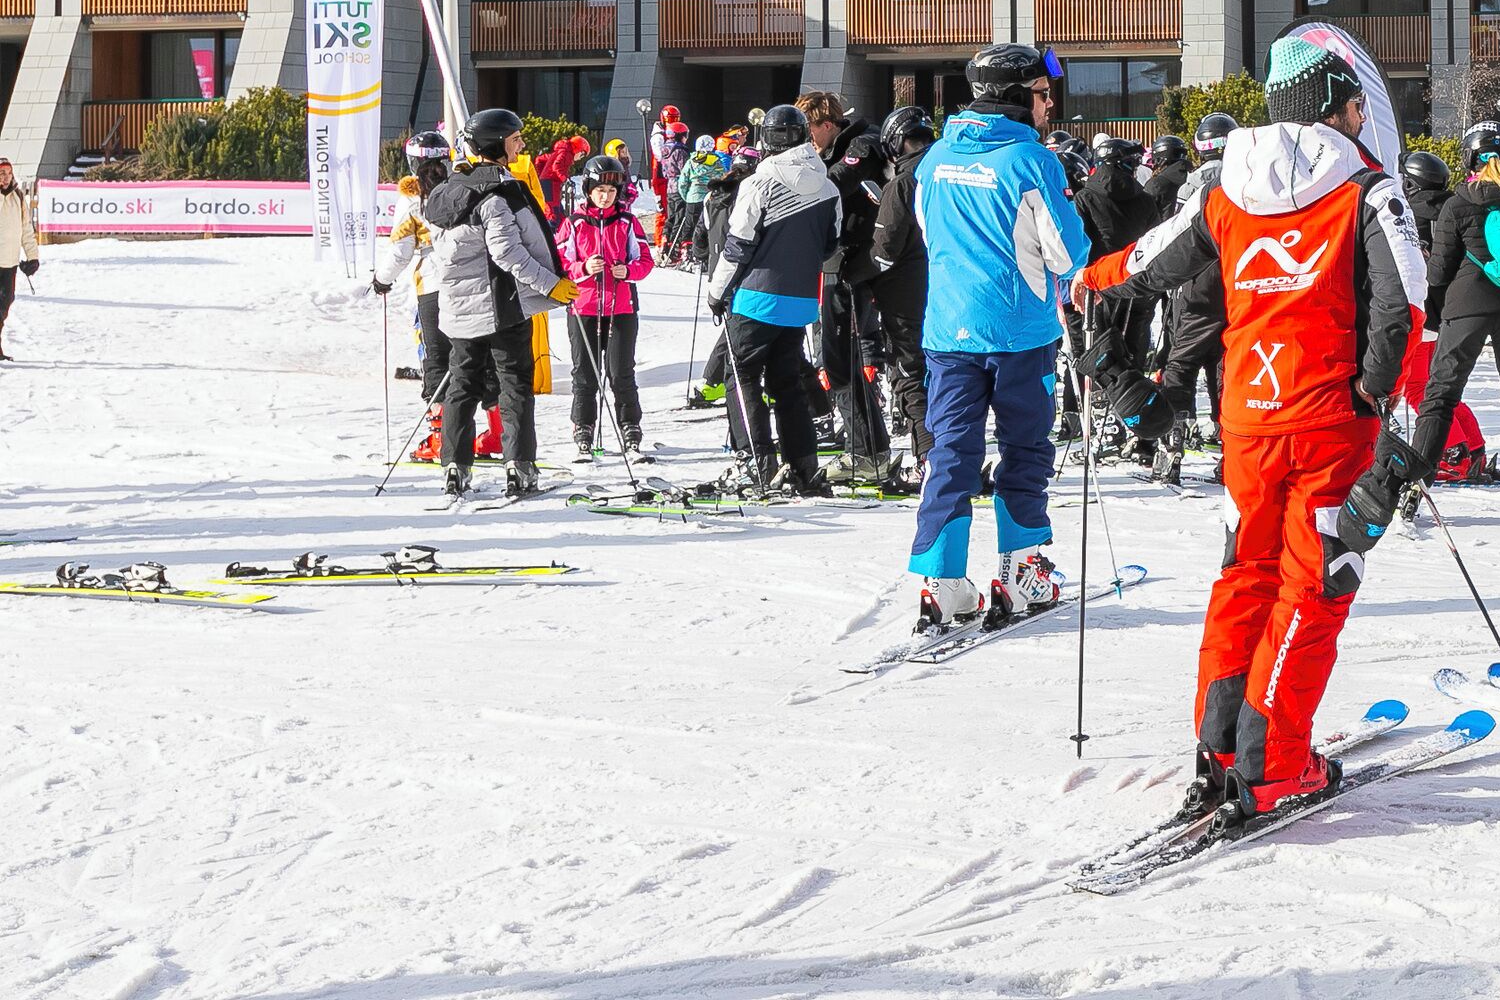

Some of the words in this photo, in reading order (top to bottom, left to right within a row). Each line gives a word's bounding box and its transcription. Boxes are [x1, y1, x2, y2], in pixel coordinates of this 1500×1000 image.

[51, 198, 152, 215] bardo.ski
[185, 197, 285, 215] bardo.ski
[1246, 399, 1283, 410] XERJOFF
[1264, 608, 1302, 708] NORDOVEST
